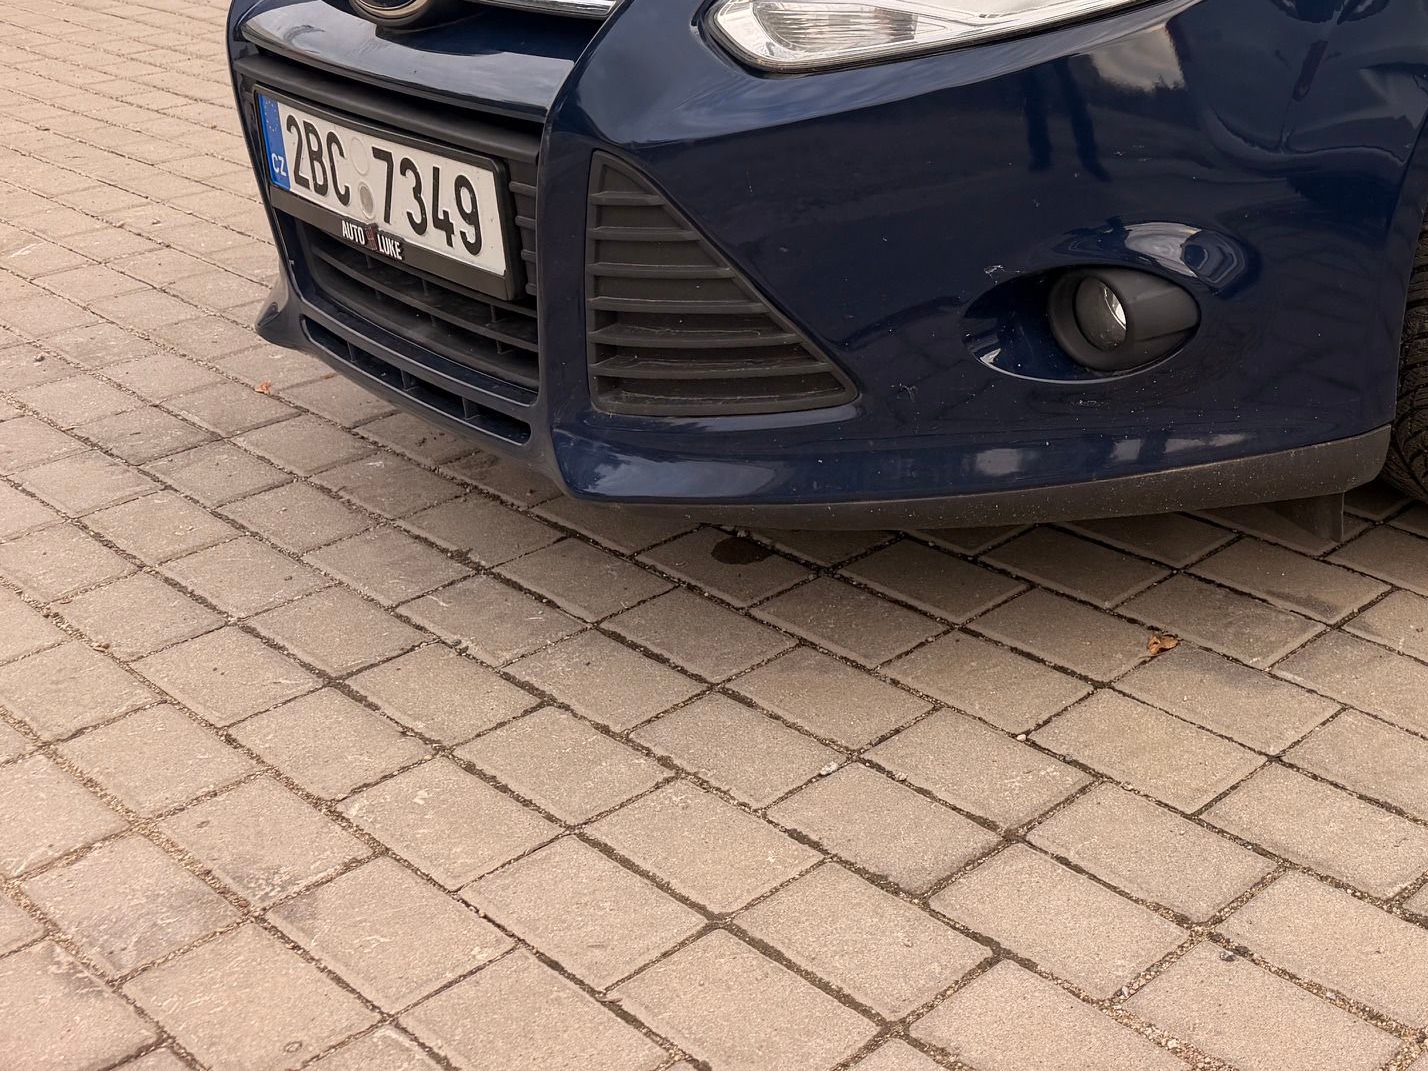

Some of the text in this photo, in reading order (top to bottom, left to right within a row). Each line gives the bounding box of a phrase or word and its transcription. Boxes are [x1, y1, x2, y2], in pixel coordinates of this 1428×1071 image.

[271, 152, 287, 177] CZ
[286, 114, 482, 256] 2BC 7349
[341, 220, 402, 260] AUTO LUKE
